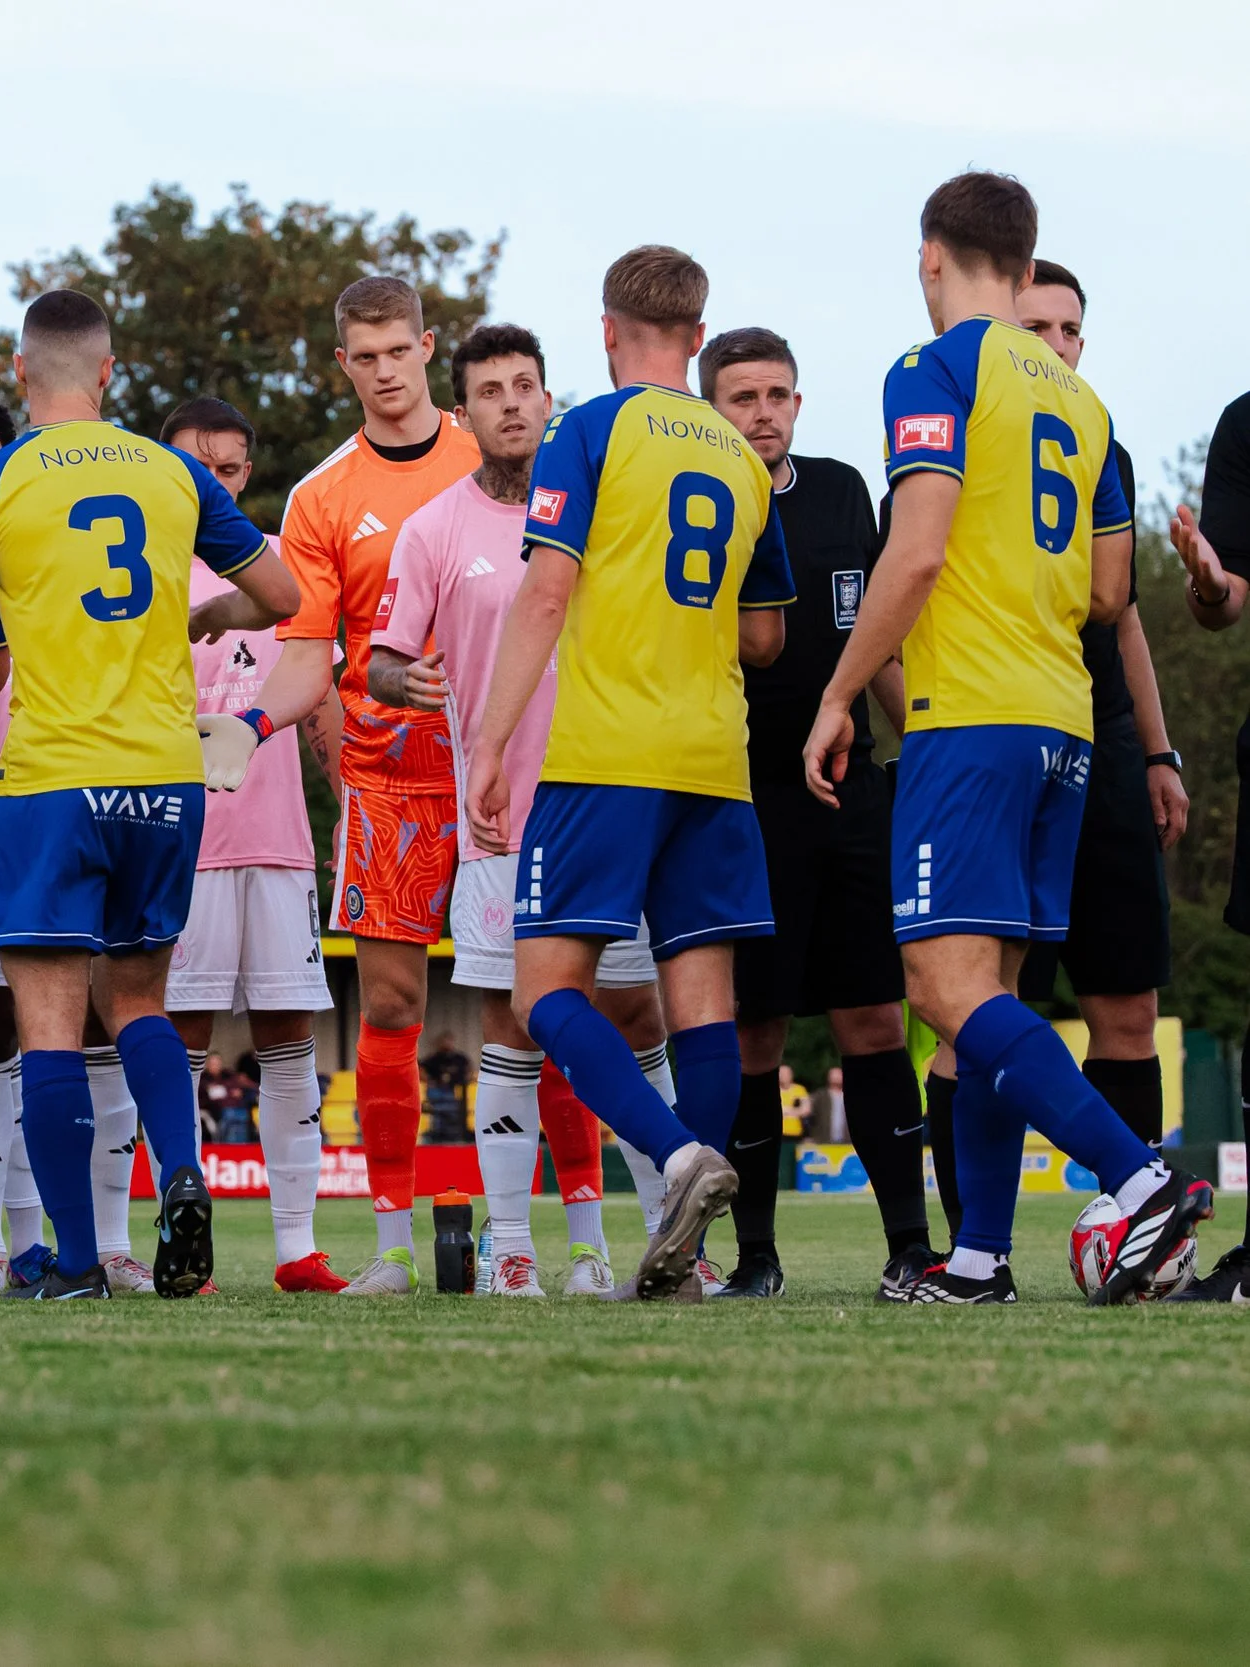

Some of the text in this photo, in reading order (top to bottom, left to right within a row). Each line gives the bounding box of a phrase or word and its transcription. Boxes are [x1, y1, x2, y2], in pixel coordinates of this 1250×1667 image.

[1008, 348, 1079, 393] Novelis
[646, 413, 743, 457] Novelis
[905, 421, 940, 433] PITCHING
[39, 443, 149, 469] Novelis
[1032, 412, 1079, 554] 6
[68, 494, 153, 622] 3
[664, 471, 736, 609] 8
[82, 790, 183, 822] WAVE
